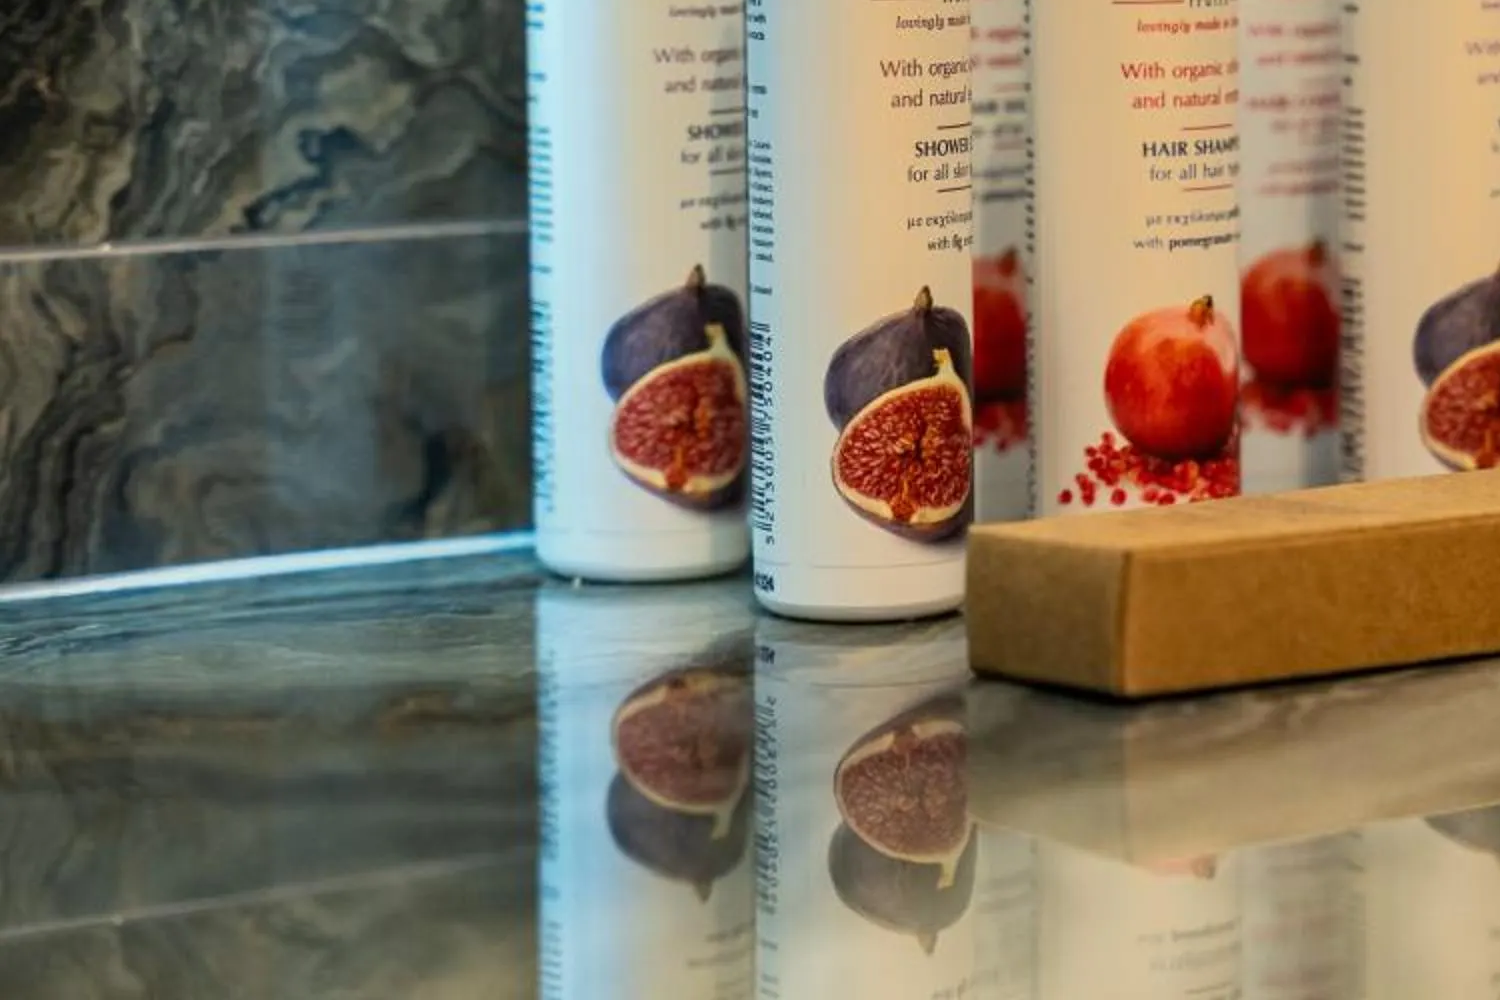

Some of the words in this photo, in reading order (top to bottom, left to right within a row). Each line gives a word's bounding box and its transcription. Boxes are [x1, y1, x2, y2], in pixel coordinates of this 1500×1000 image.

[880, 57, 923, 78] With
[1120, 61, 1166, 79] With
[1172, 63, 1223, 82] organic
[891, 88, 923, 108] and
[1132, 91, 1165, 109] and
[1173, 85, 1222, 107] natural
[1142, 141, 1188, 158] HAIR
[907, 164, 929, 182] for
[933, 163, 949, 180] all
[1150, 164, 1172, 182] for
[1179, 163, 1197, 180] all
